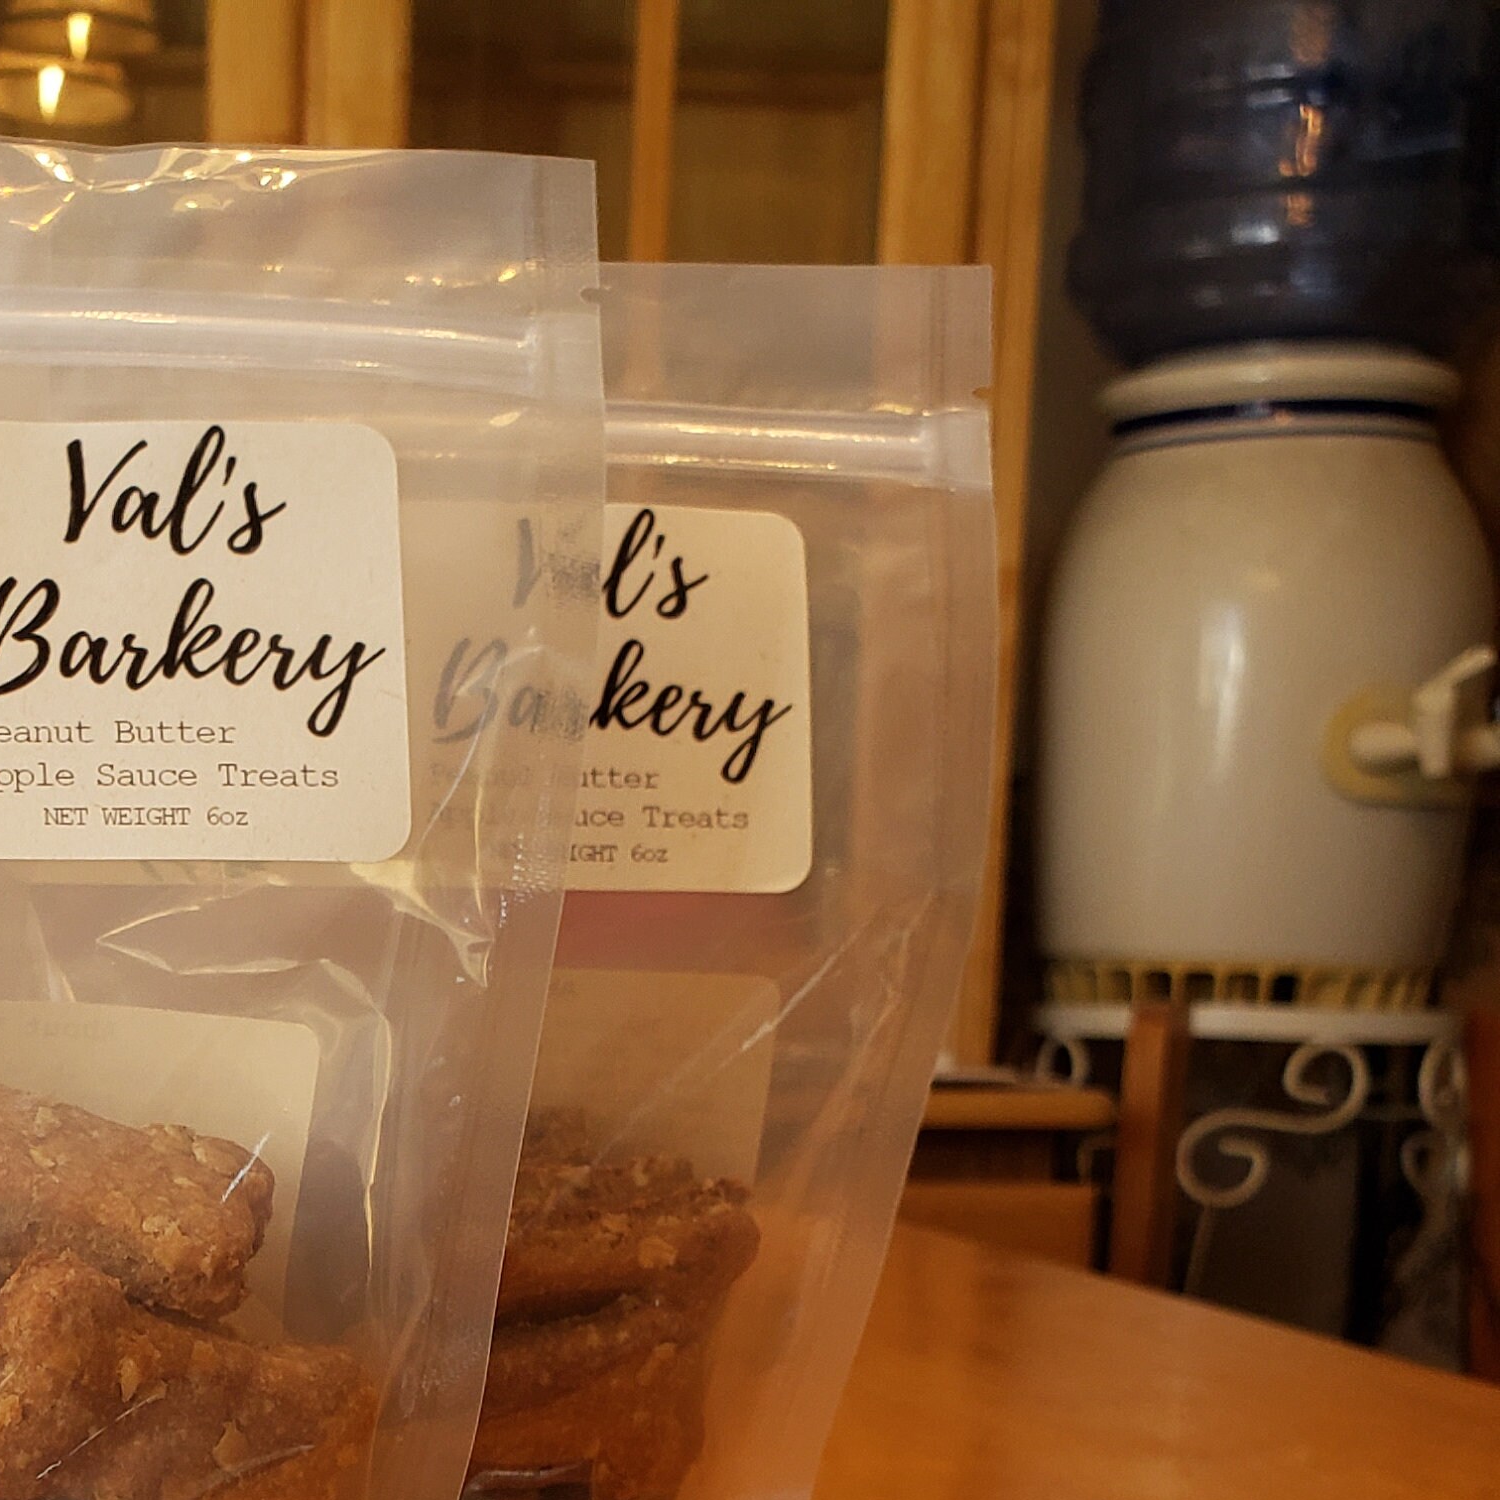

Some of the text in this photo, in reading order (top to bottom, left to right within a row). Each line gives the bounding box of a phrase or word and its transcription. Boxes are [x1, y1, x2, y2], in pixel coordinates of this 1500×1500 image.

[62, 424, 288, 557] Val's
[113, 720, 238, 745] Butter
[96, 762, 199, 788] Sauce
[217, 763, 340, 789] Treats
[581, 766, 660, 790] tter
[42, 806, 250, 827] NET WEIGHT 6oz
[641, 805, 750, 829] Treats
[569, 842, 669, 863] IGHT 6oz
